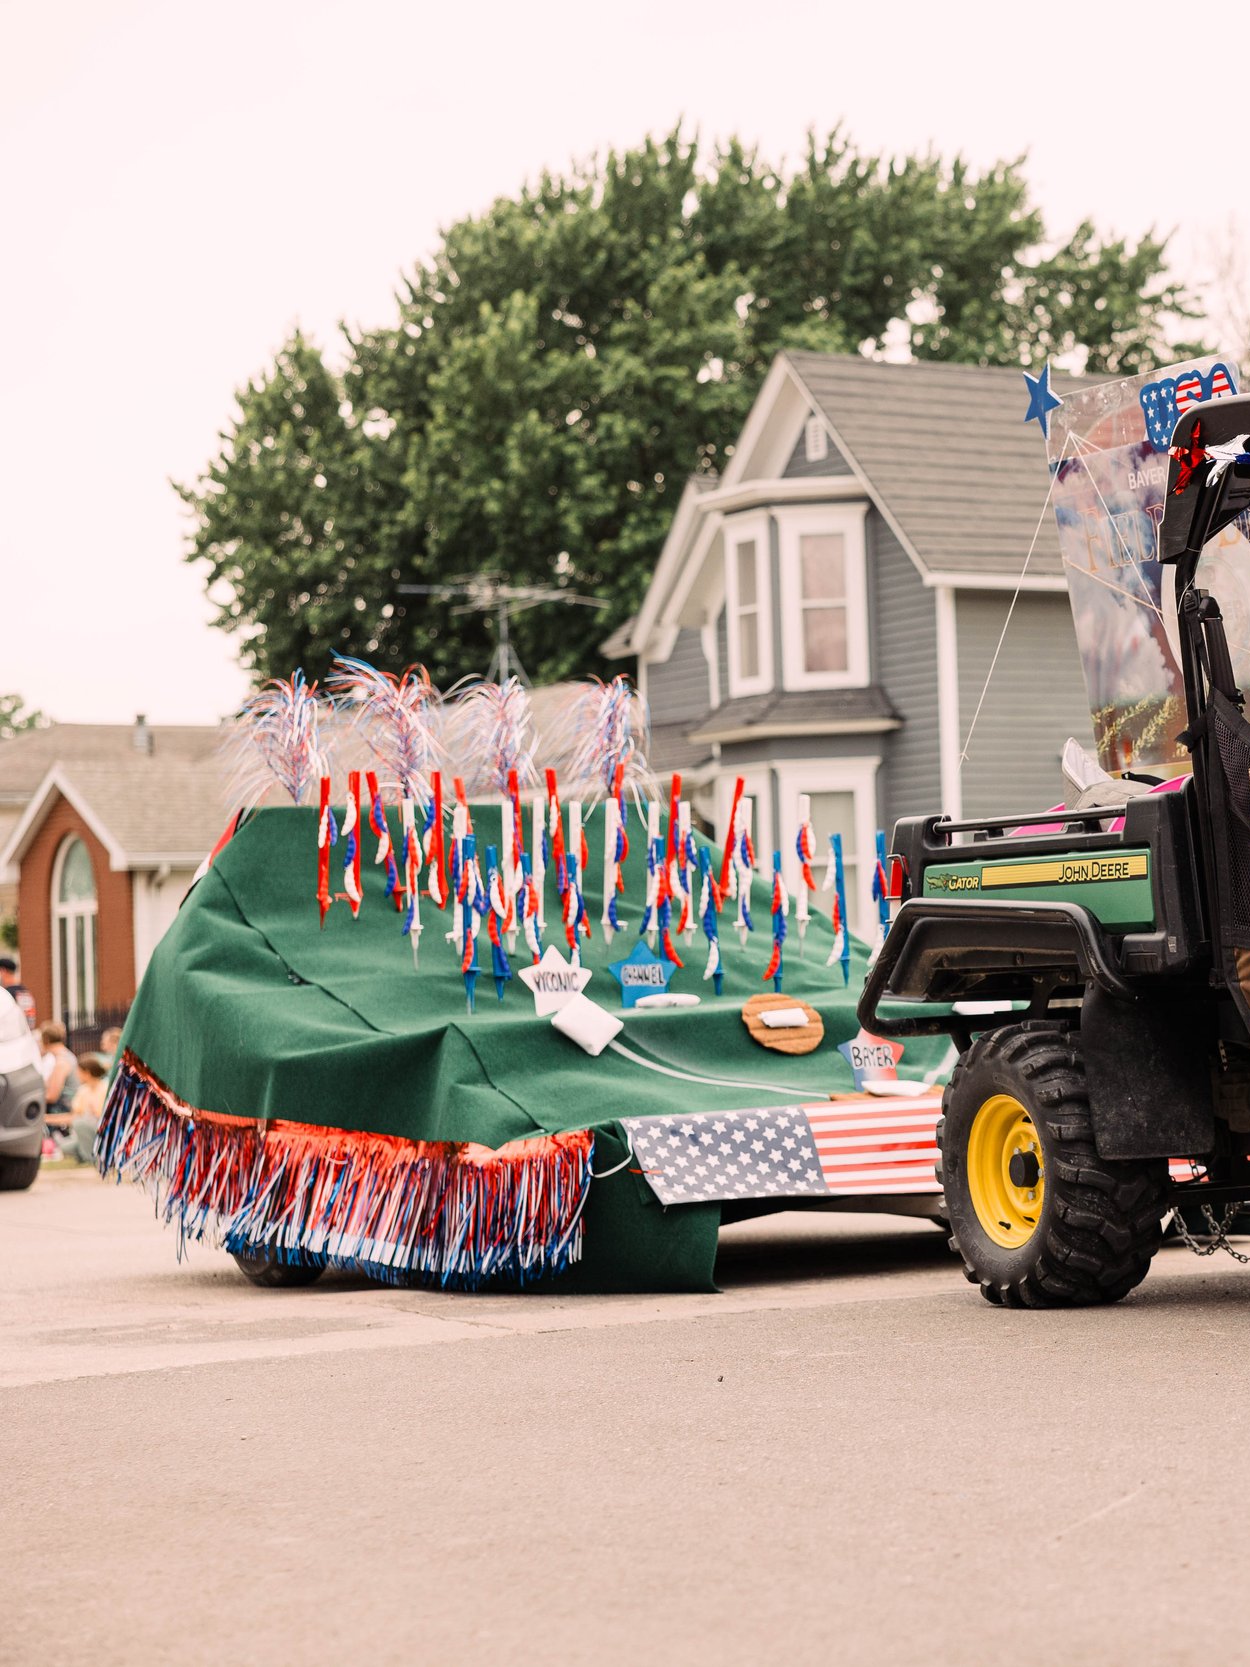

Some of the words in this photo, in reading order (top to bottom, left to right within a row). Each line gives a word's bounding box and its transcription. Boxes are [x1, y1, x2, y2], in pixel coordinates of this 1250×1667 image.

[1128, 467, 1166, 490] BAYER
[948, 875, 980, 891] GATOR
[1058, 864, 1090, 883] JOHN
[1091, 861, 1130, 880] DEERE
[851, 1045, 894, 1068] BAYER
